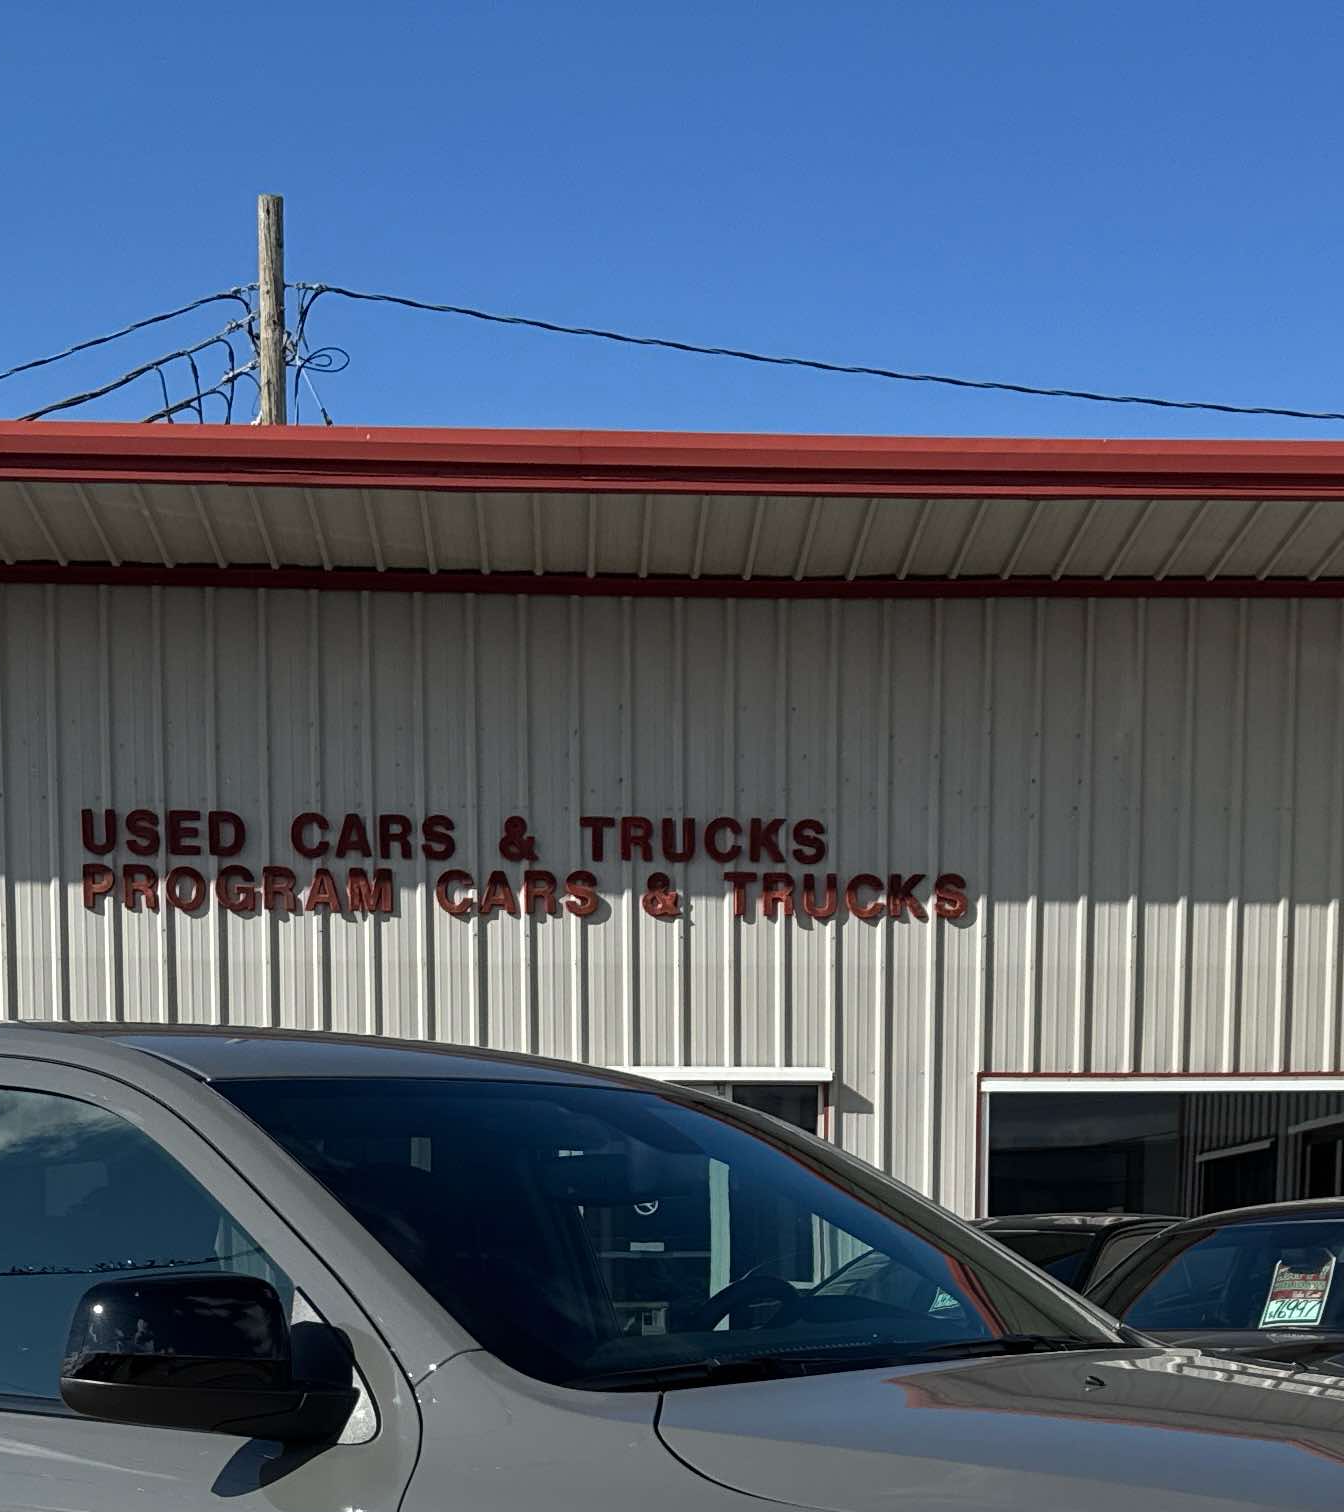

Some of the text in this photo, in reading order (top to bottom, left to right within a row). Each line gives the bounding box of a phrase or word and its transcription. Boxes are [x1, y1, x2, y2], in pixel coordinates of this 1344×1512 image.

[81, 809, 827, 864] USED CARS & TRUCKS
[82, 864, 967, 918] PROGRAM CARS & TRUCKS
